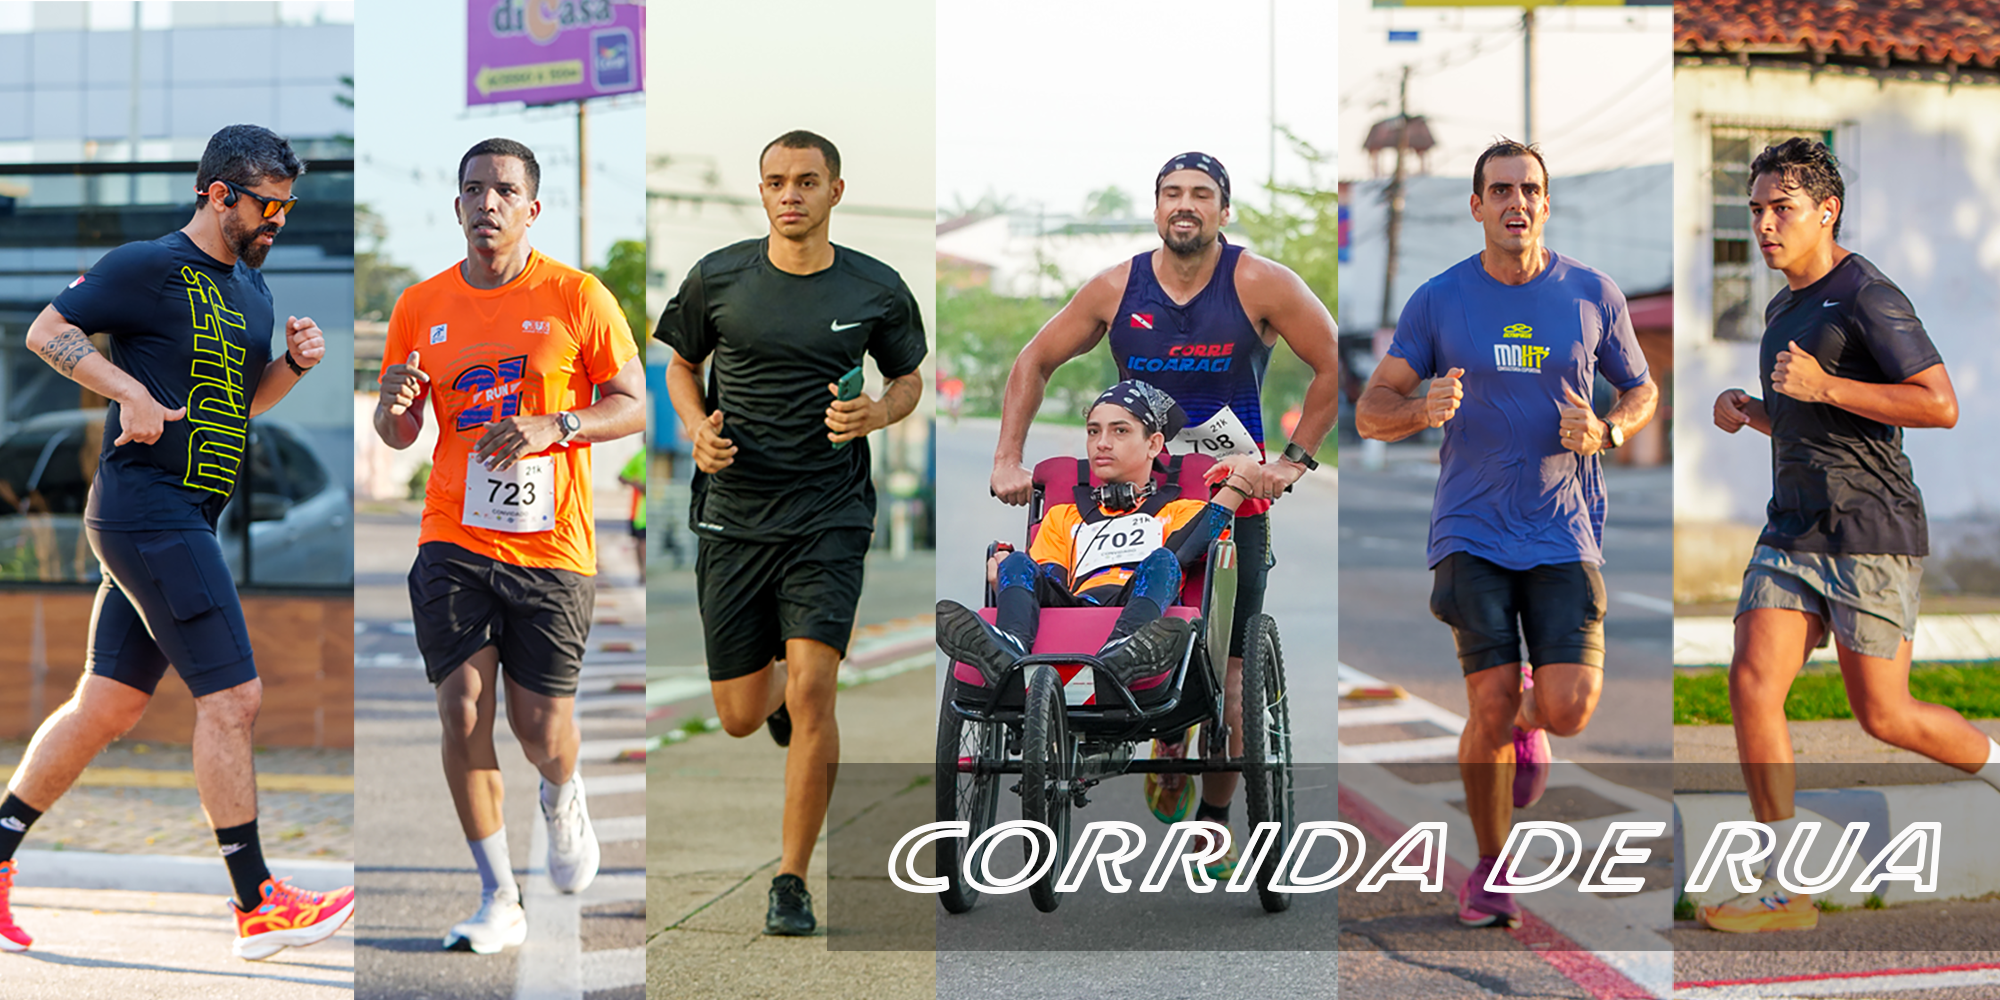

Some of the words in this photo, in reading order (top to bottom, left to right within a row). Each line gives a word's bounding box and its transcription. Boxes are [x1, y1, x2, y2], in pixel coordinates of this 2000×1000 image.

[1169, 343, 1235, 357] CORRE
[1127, 356, 1232, 372] ICOARACI
[485, 384, 509, 402] RUN
[1209, 418, 1228, 432] 21k
[1185, 434, 1235, 453] 708
[525, 465, 542, 476] 21k
[487, 478, 536, 506] 723
[1132, 516, 1150, 526] 21k
[1096, 528, 1145, 551] 702
